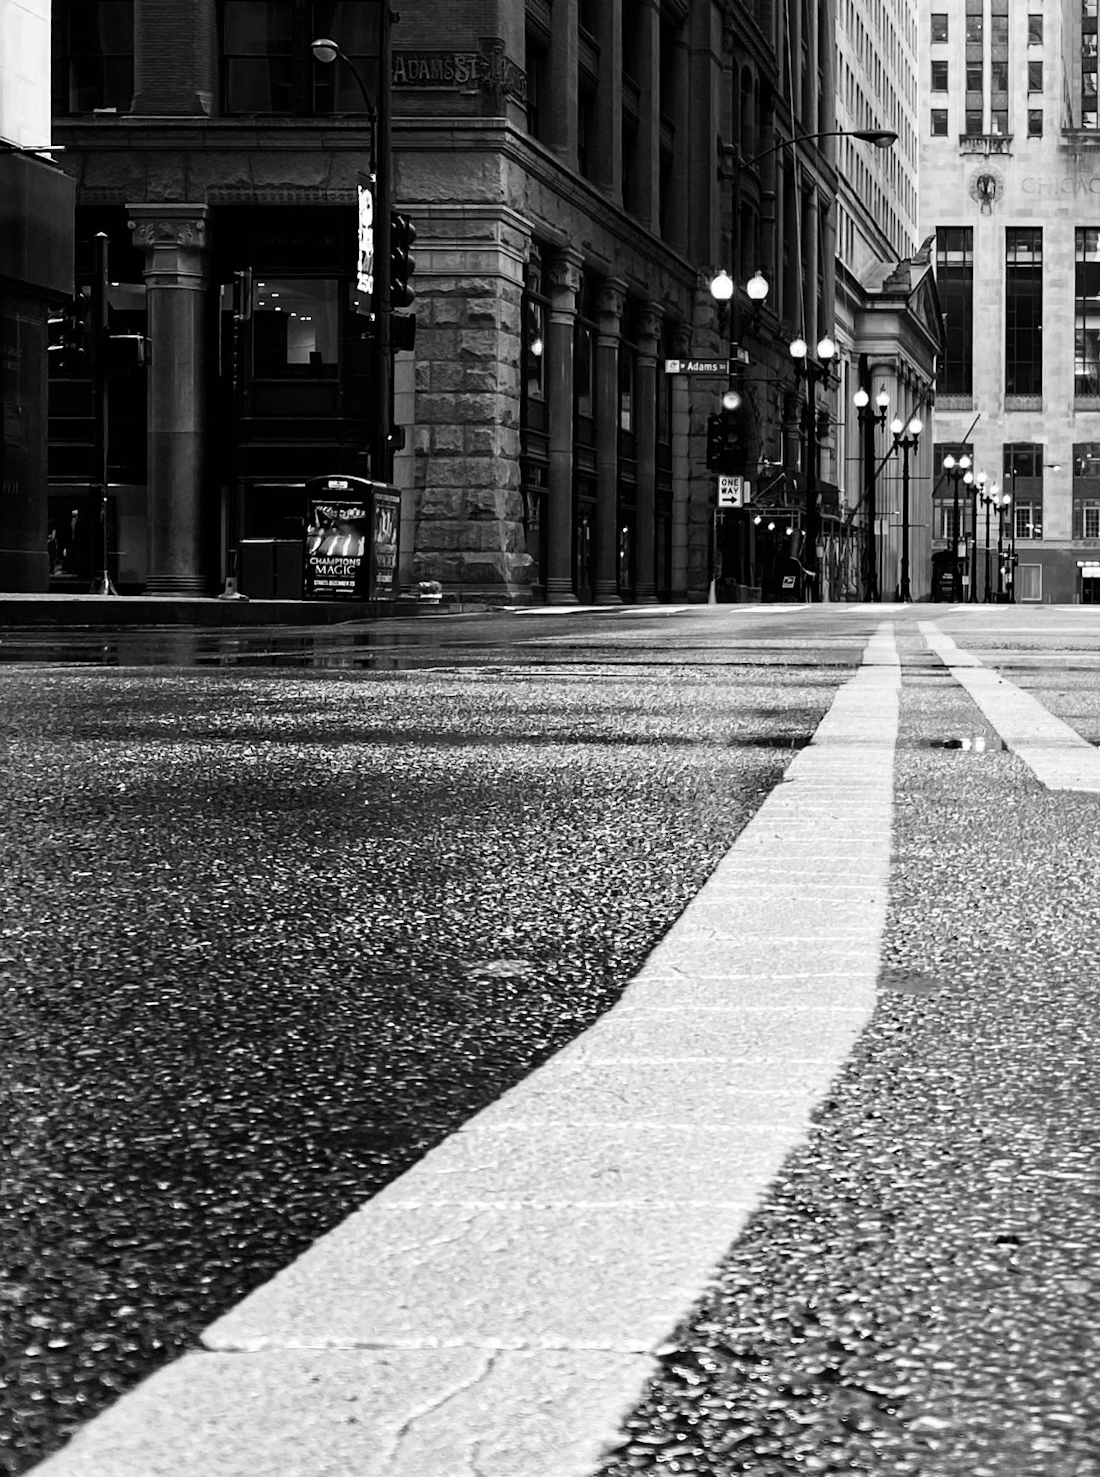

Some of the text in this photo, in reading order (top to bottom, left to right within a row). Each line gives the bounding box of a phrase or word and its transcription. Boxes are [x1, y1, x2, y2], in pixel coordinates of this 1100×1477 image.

[687, 361, 717, 371] Adams
[721, 479, 739, 487] ONE
[721, 487, 739, 495] WAY
[309, 557, 361, 566] CHAMPIONS
[315, 565, 356, 575] MAGIC
